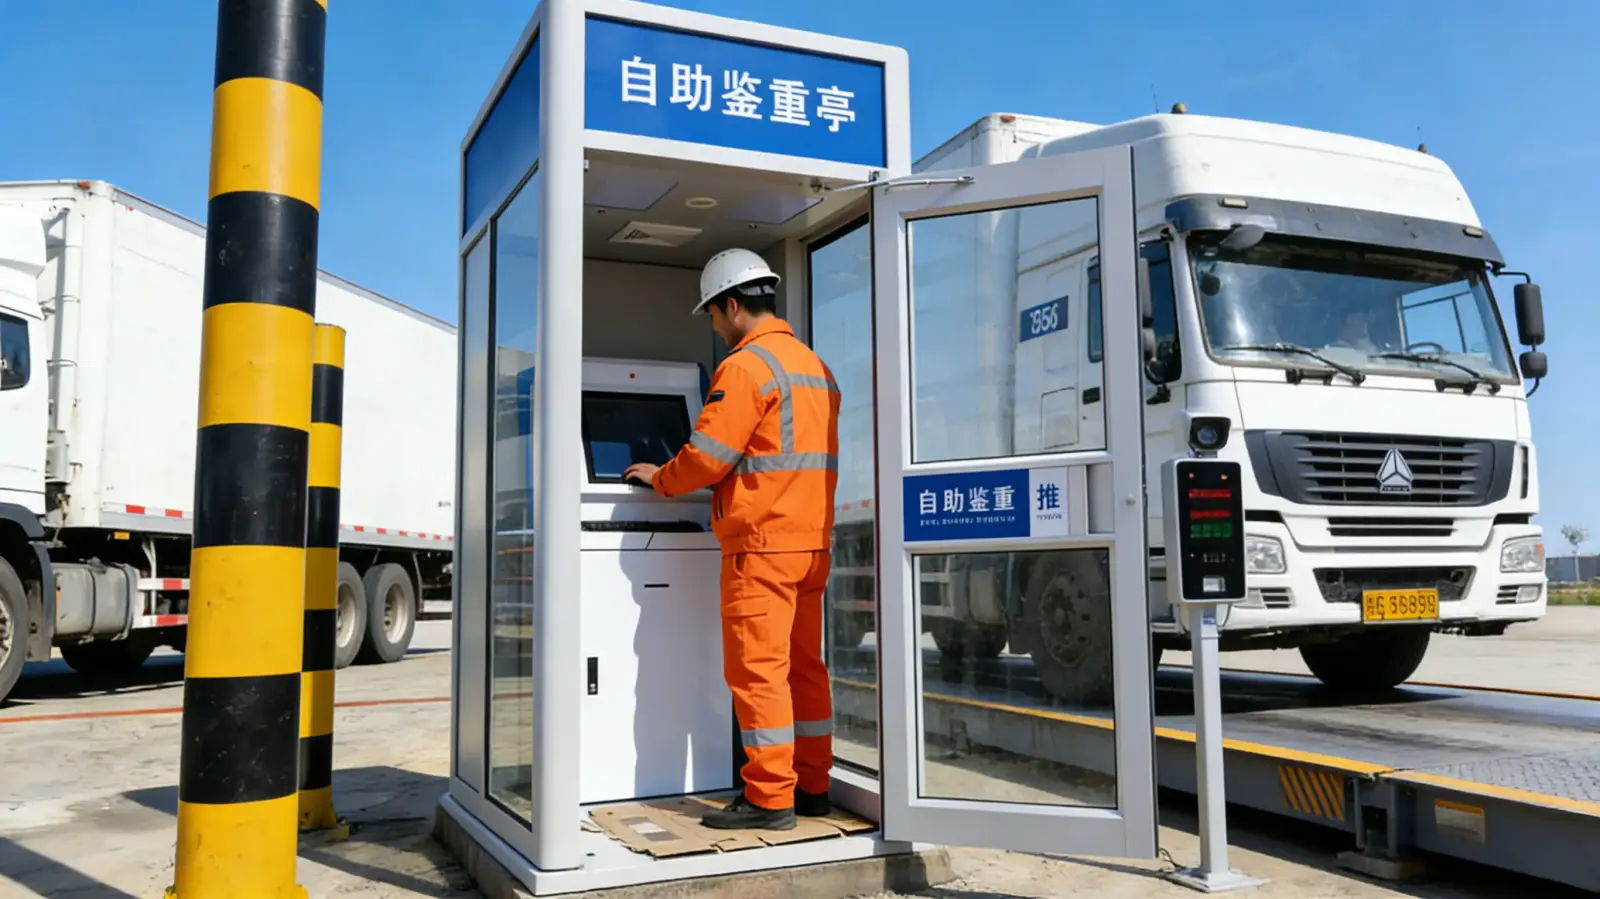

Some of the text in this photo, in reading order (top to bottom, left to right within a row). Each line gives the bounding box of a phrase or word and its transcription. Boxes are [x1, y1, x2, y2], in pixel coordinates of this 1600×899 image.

[621, 56, 855, 132] 自助鉴重亭
[919, 485, 1015, 515] 自助鉴重
[1036, 483, 1060, 511] 推
